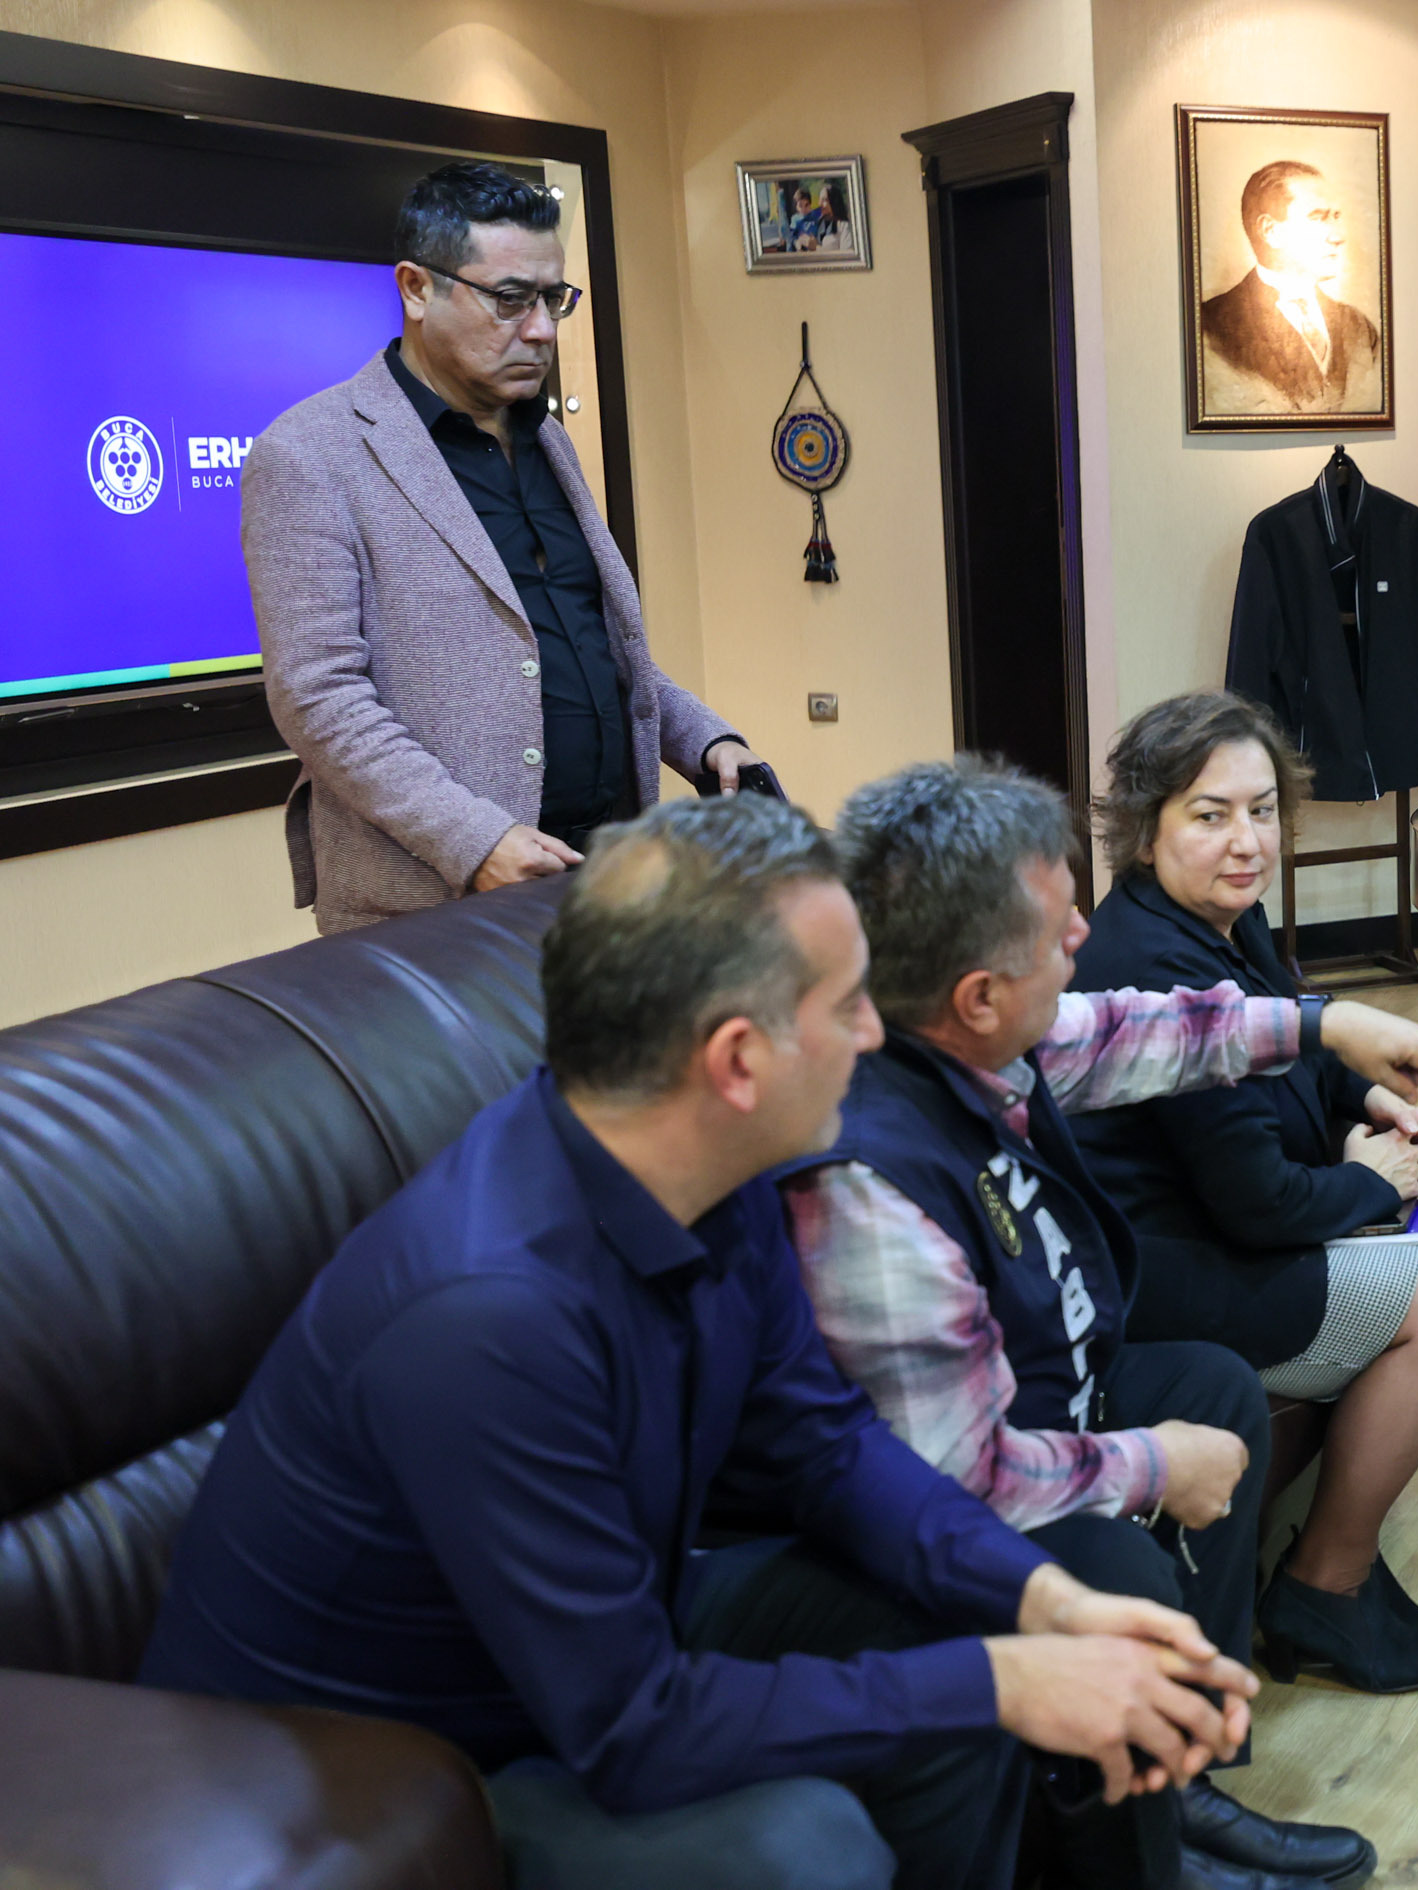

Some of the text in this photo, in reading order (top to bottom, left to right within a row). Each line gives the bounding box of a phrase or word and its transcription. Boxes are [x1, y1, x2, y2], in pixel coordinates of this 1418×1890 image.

[100, 422, 144, 441] BUCA
[191, 475, 234, 488] BUCA
[95, 476, 159, 510] BELEDİYESİ
